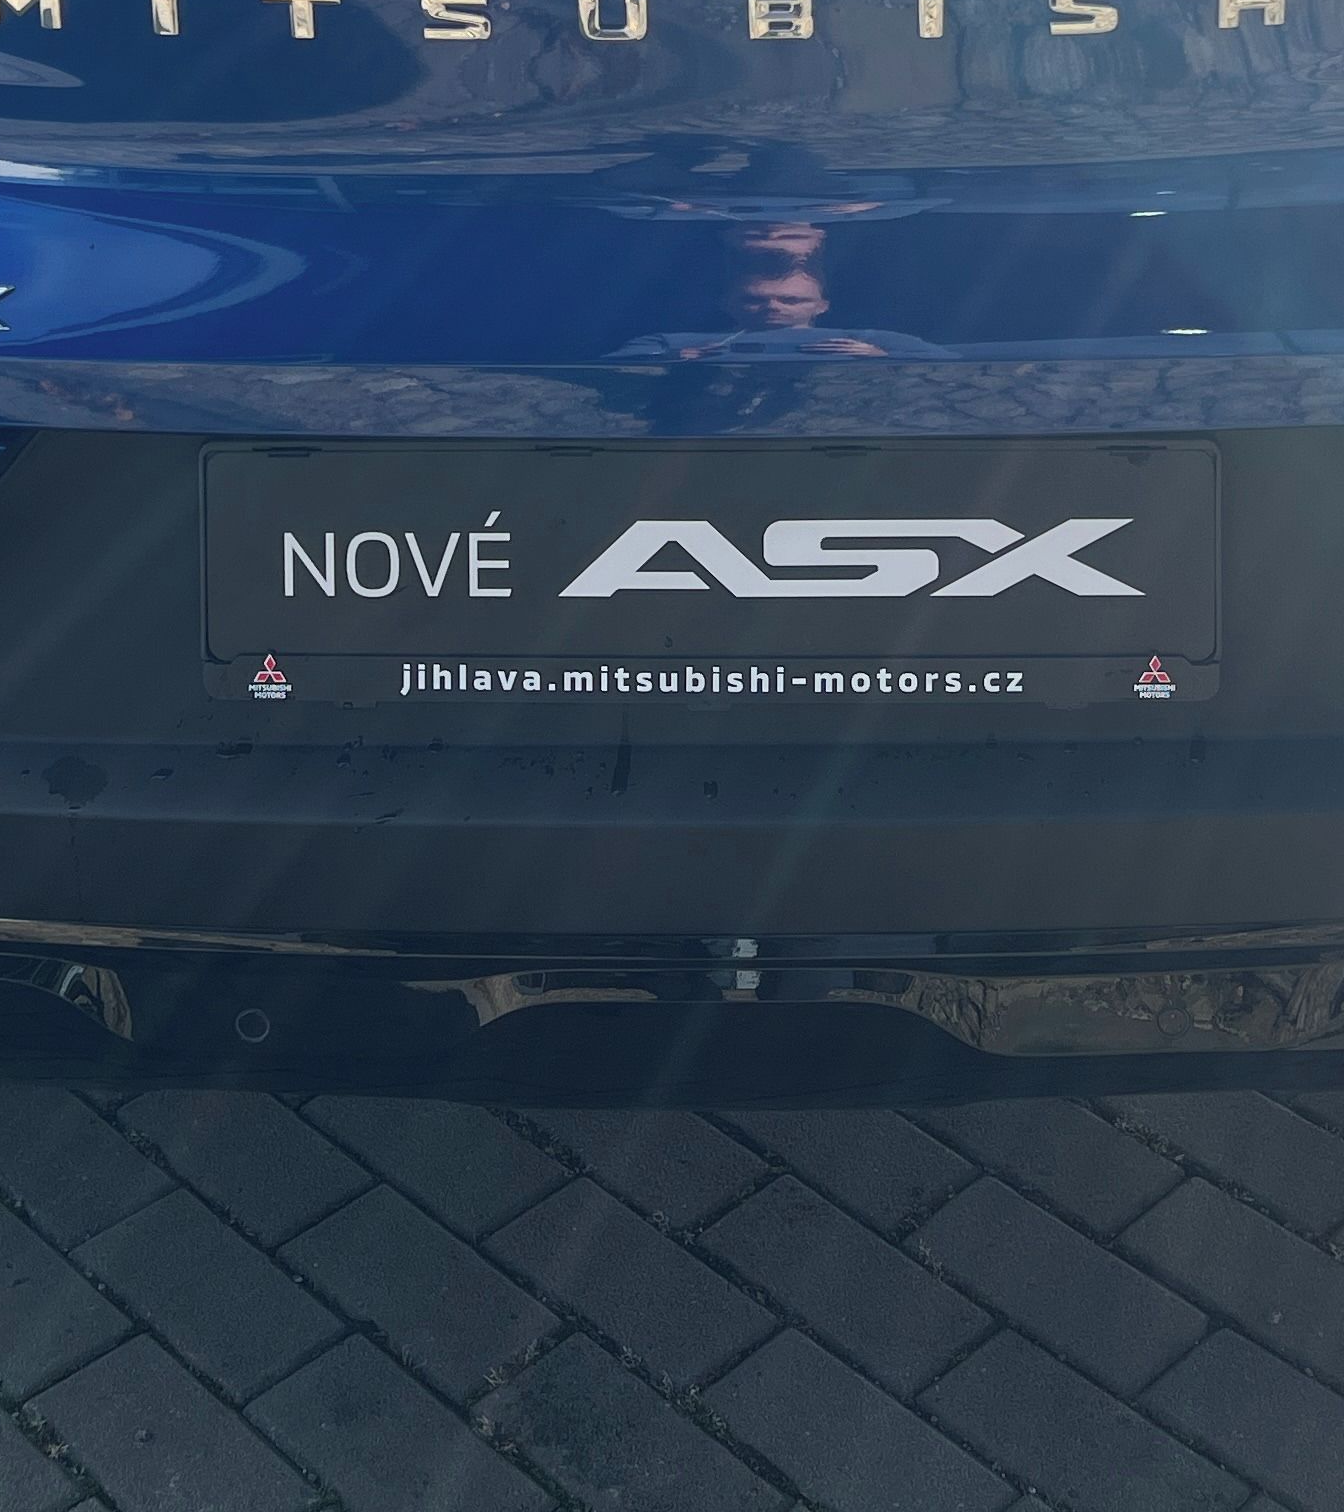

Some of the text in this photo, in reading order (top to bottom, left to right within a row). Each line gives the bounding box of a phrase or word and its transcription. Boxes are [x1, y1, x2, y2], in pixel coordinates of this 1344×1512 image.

[283, 510, 1146, 598] NOVÉ ASX
[399, 663, 1024, 696] jihlava.mitsubishi-motors.cz
